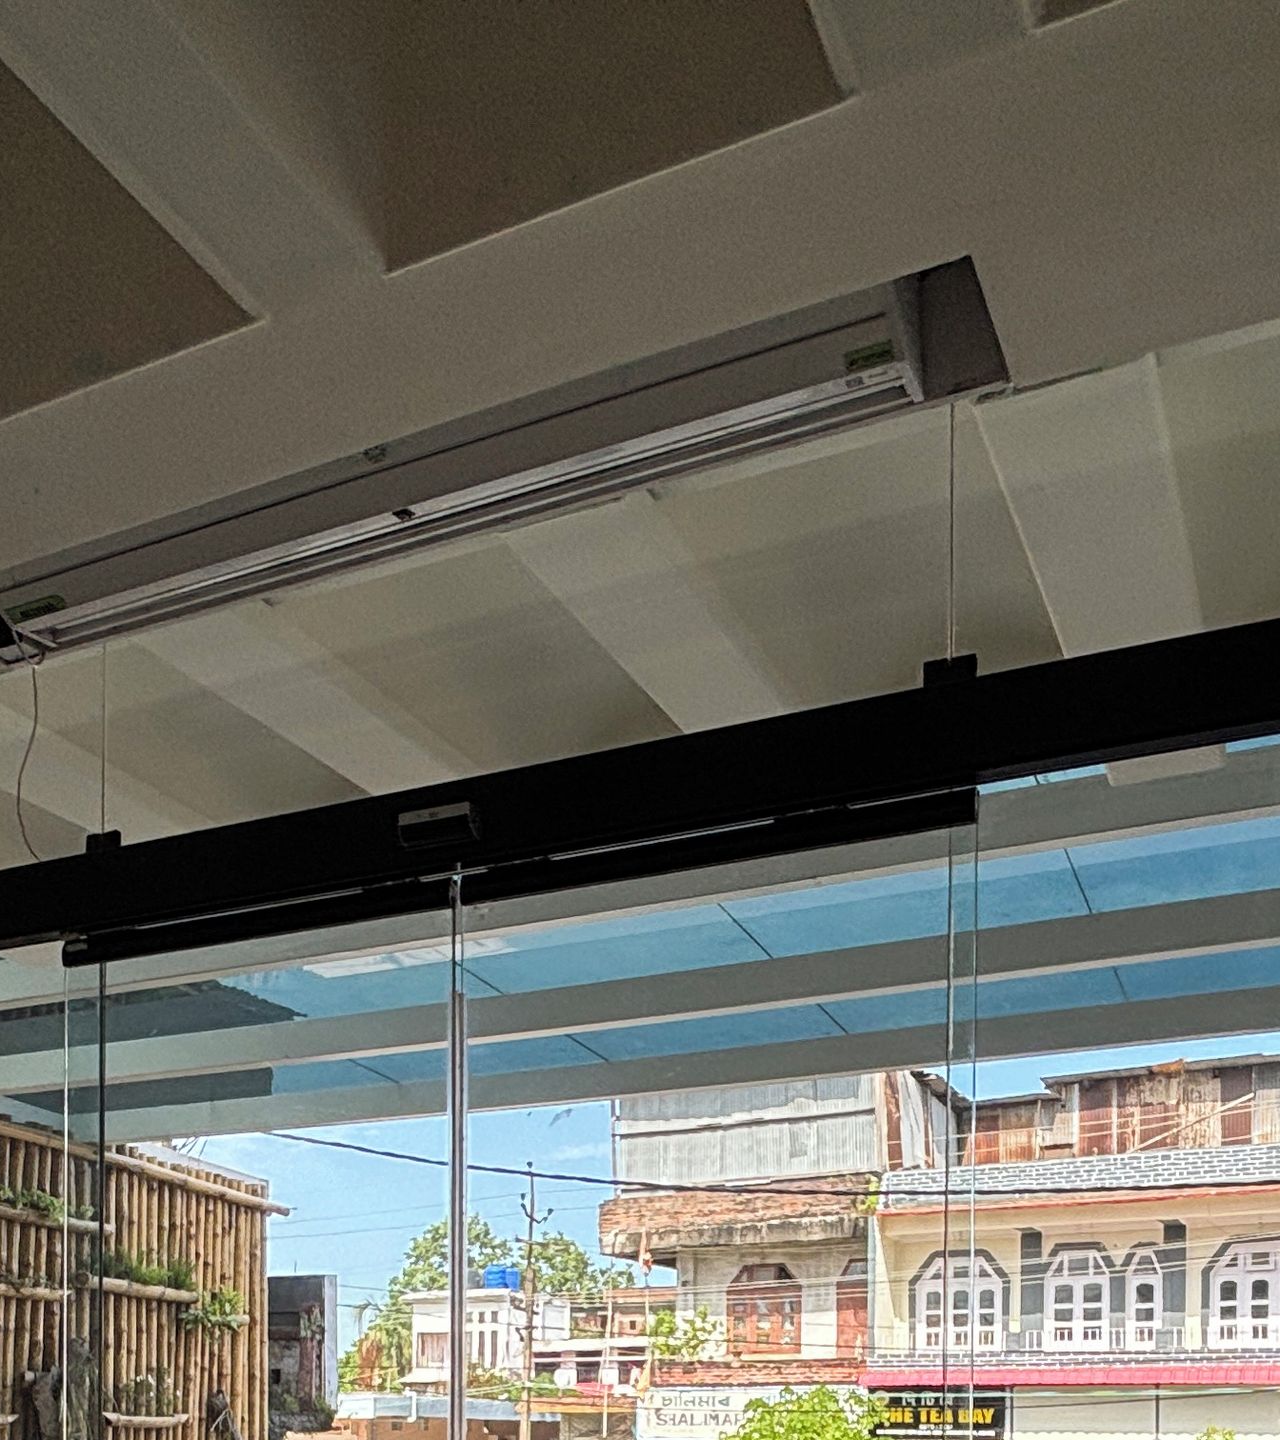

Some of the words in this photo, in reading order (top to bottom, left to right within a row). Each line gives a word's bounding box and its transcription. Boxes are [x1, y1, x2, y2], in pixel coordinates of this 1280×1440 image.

[886, 1407, 914, 1424] HE
[918, 1407, 954, 1424] TEA
[958, 1407, 996, 1424] BAY
